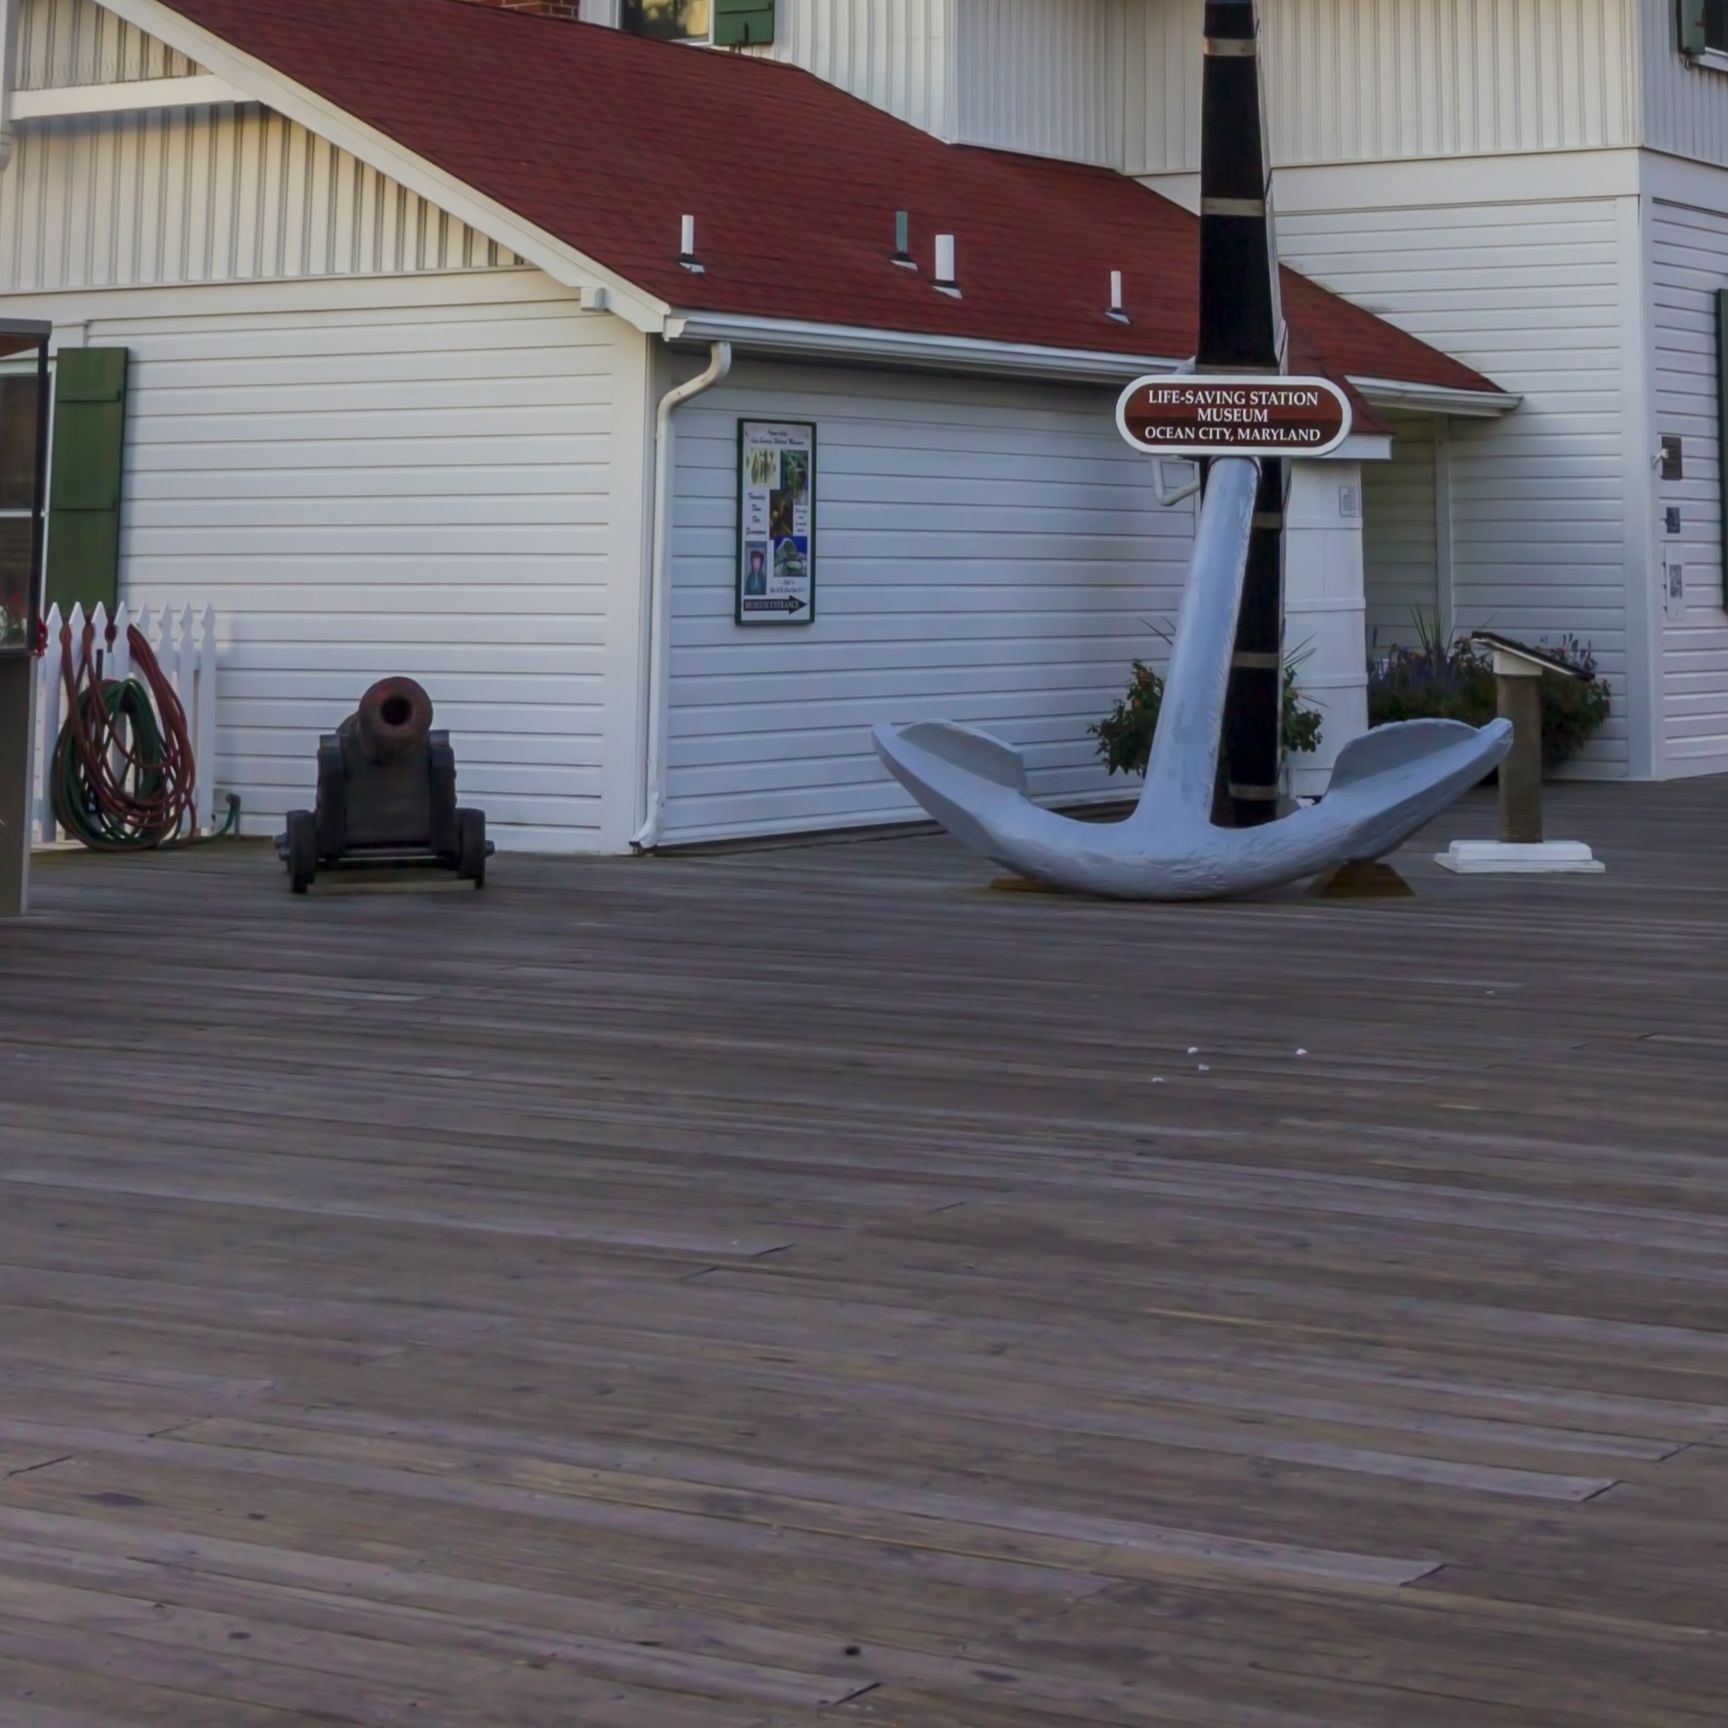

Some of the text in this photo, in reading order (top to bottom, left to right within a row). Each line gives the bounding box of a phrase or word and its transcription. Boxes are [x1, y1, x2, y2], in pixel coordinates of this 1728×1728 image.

[1148, 389, 1318, 407] LIFE-SAVING STATION
[1197, 408, 1268, 423] MUSEUM
[1145, 426, 1320, 443] OCEAN CITY, MARYLAND
